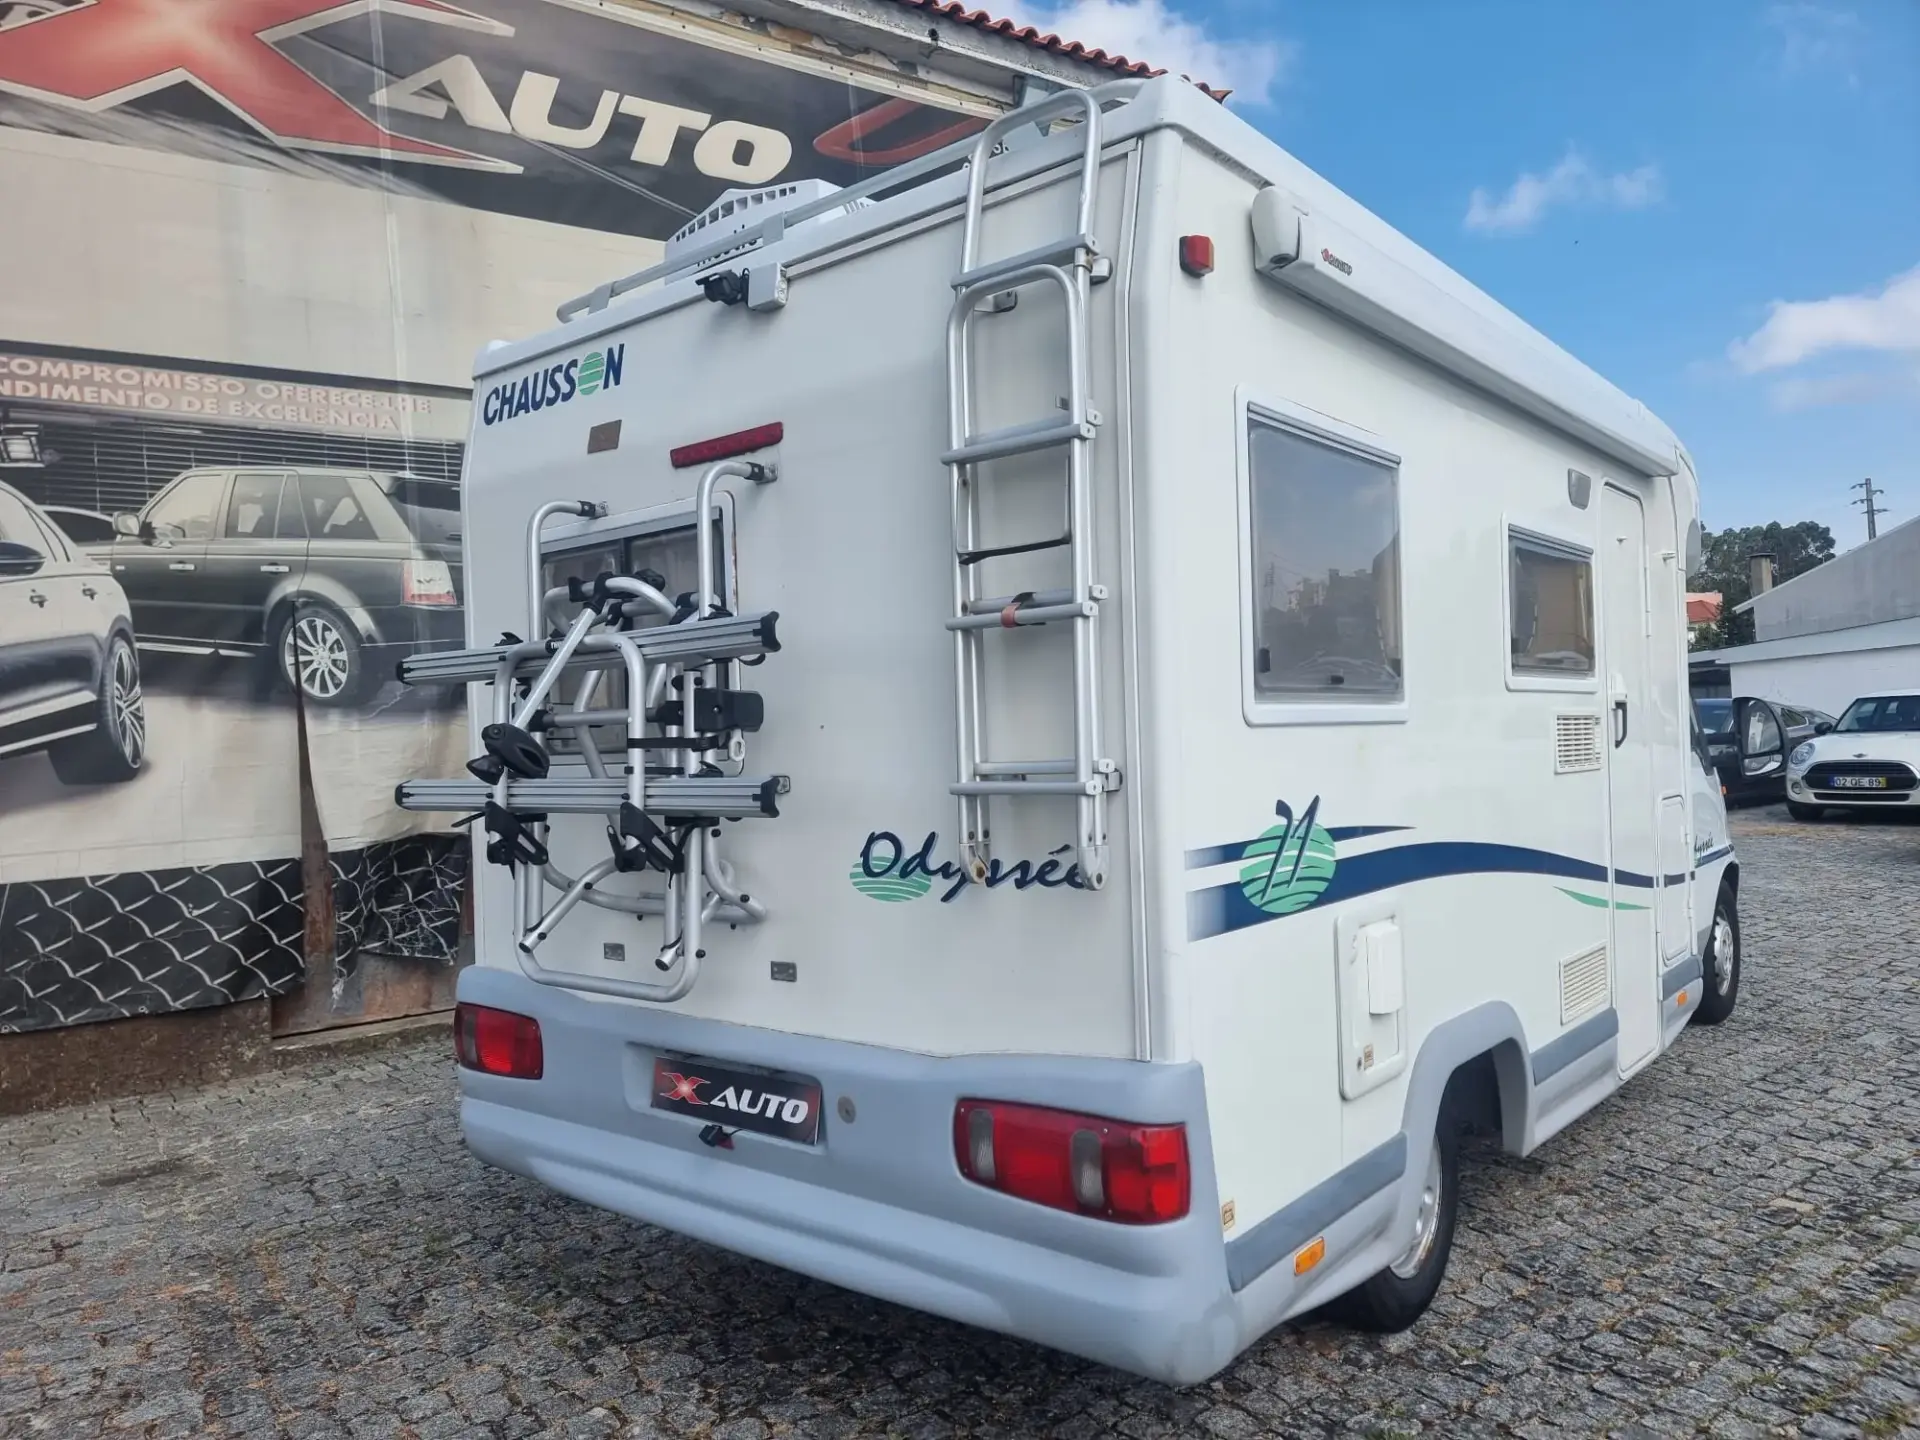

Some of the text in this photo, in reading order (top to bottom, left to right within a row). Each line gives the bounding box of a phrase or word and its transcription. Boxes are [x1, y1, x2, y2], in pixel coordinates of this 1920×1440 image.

[369, 53, 793, 185] AUTO
[181, 395, 220, 414] DE
[483, 343, 625, 426] CHAUSSON
[709, 1085, 809, 1124] AUTO
